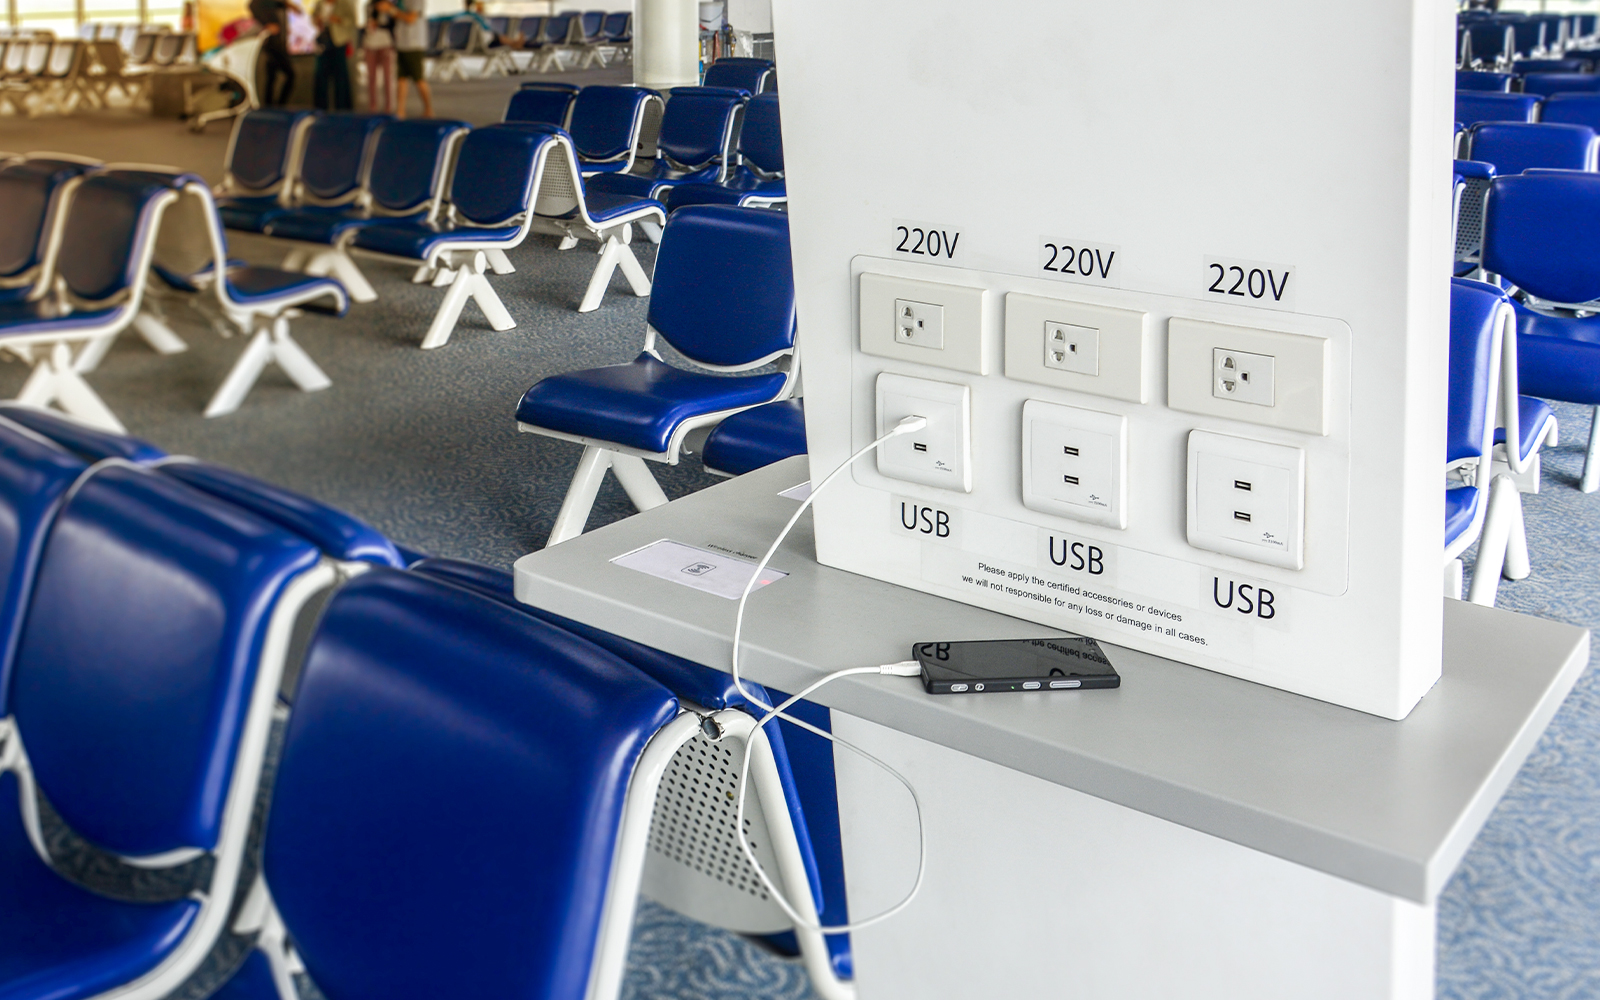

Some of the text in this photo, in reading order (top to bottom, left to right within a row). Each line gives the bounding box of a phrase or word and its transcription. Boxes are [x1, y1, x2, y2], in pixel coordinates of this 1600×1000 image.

[896, 226, 959, 258] 220V
[1044, 244, 1114, 278] 220V
[1209, 264, 1289, 301] 220V
[902, 502, 949, 537] USB
[1050, 536, 1103, 574] USB
[962, 575, 1208, 646] we will not responsible for any loss or damage in all cases.
[978, 562, 1182, 622] Please apply the certified accessories or devices
[1214, 577, 1274, 619] USB
